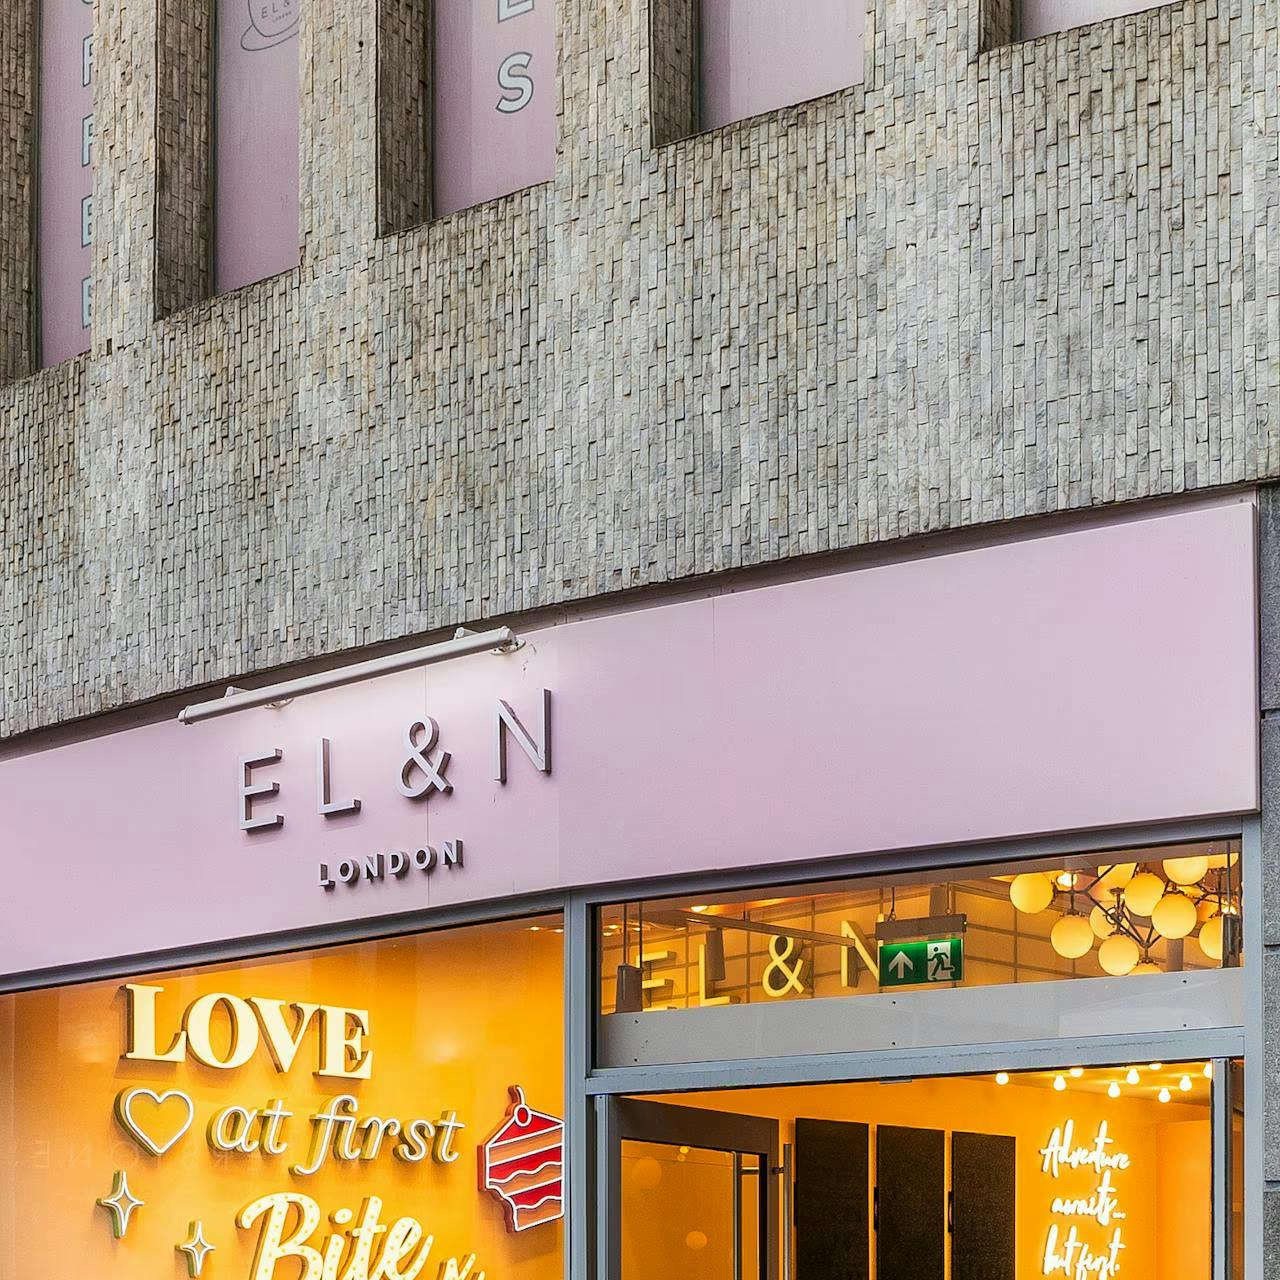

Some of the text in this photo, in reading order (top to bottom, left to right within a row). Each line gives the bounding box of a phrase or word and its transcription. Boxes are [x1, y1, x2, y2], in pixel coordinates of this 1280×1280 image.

[319, 839, 463, 890] LONDON
[120, 983, 373, 1080] LOVE
[207, 1098, 293, 1155] at
[289, 1094, 466, 1176] first
[1040, 1119, 1131, 1178] Adventure
[1043, 1223, 1082, 1276] but
